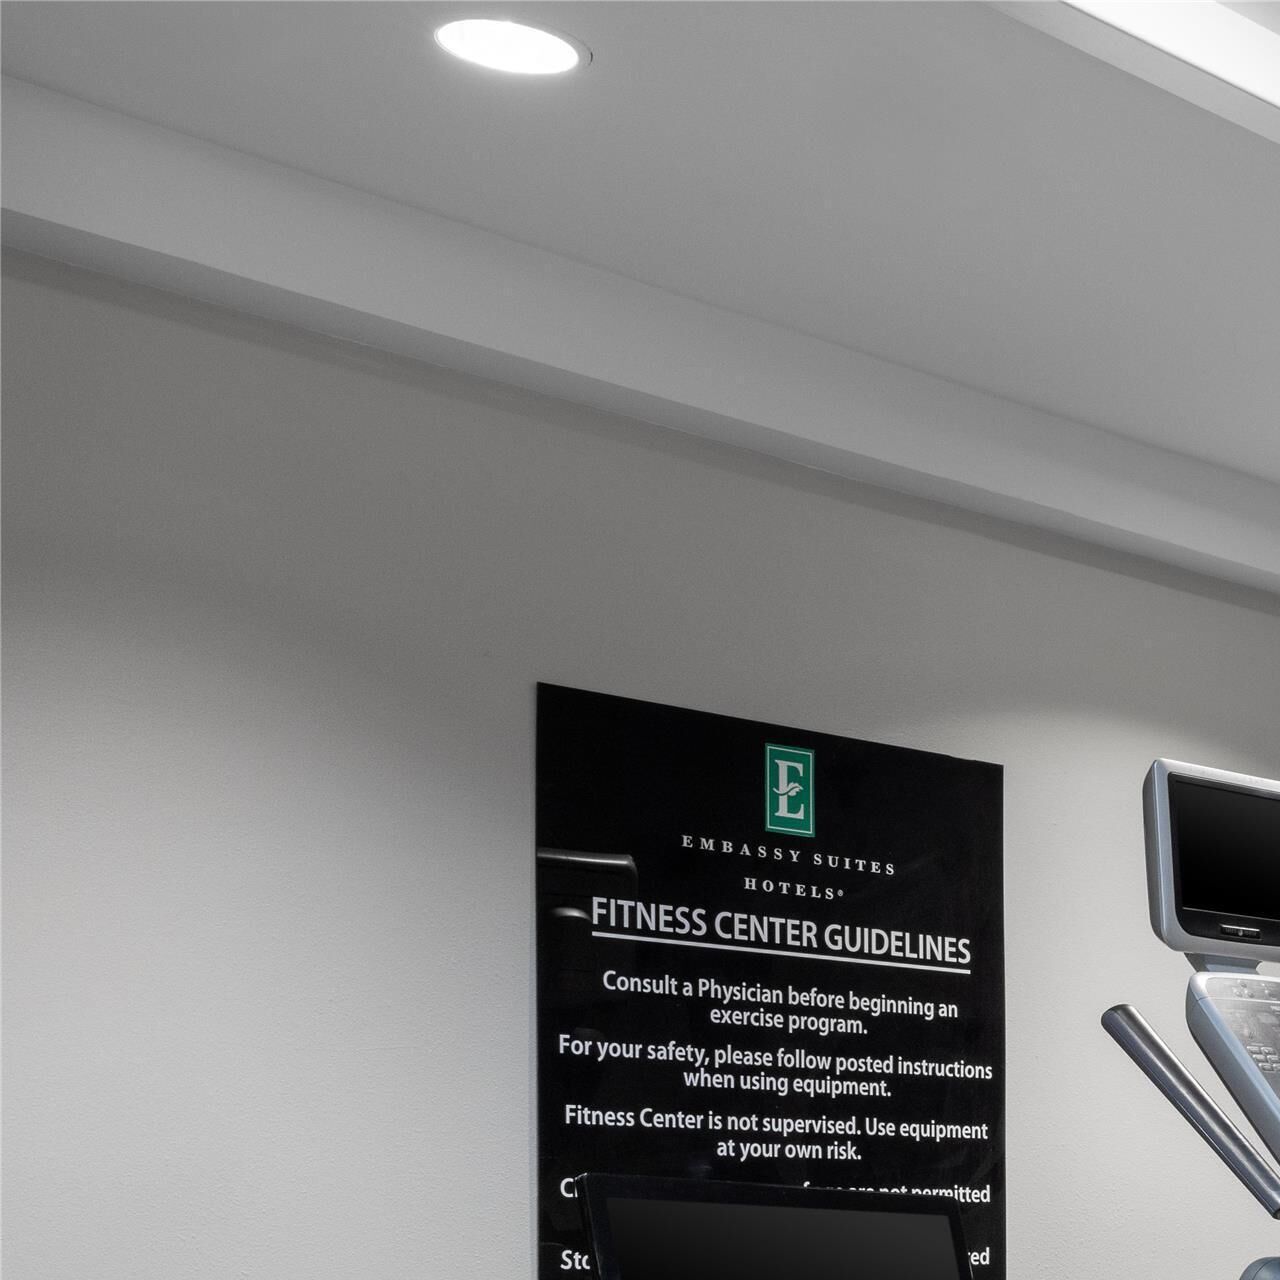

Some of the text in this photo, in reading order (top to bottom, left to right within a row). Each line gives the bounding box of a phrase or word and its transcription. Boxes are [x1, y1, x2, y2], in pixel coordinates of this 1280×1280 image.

[682, 835, 895, 876] EMBASSY SUITES
[592, 896, 971, 965] FITNESS CENTER GUIDELINES
[602, 969, 959, 1021] Consult a Physician before beginning an
[710, 1007, 868, 1037] exercise program.
[559, 1033, 993, 1080] For your safety, please follow posted instructions
[683, 1067, 892, 1099] when using equipment.
[565, 1104, 989, 1143] Fitness Center is not supervised. Use equipment
[716, 1139, 862, 1163] at your own risk.
